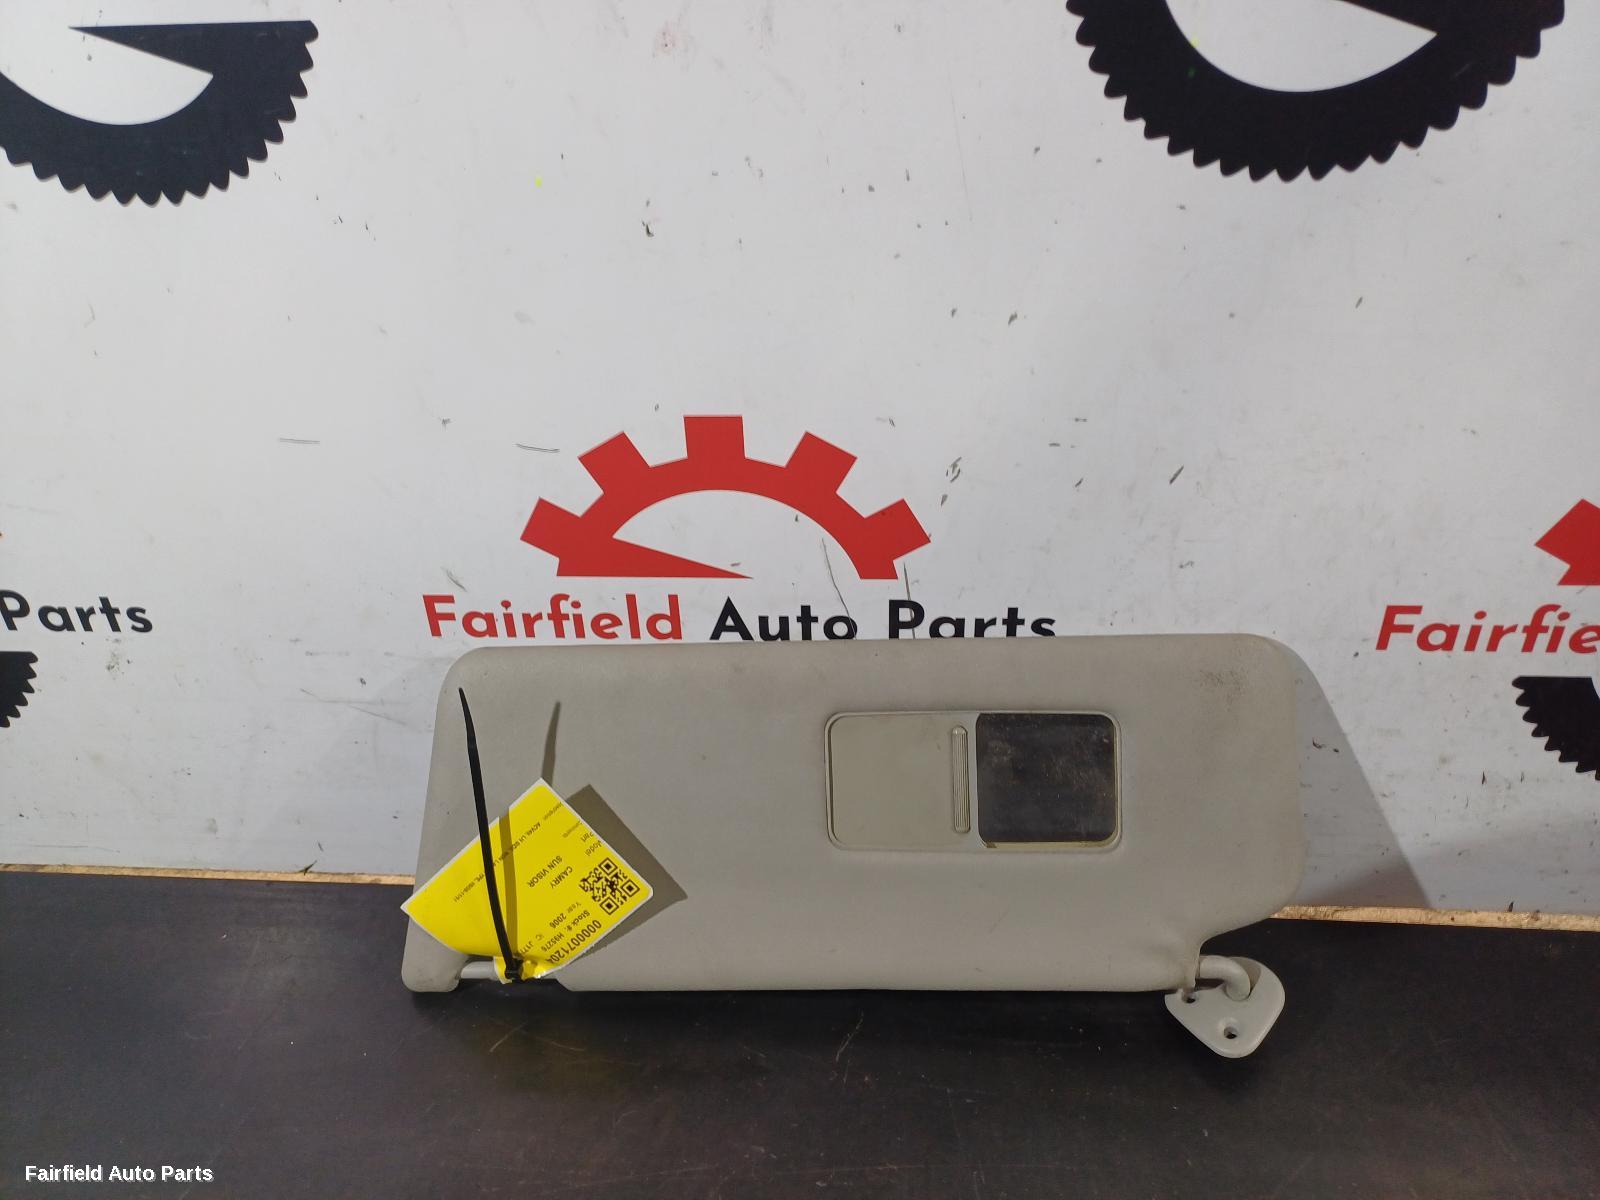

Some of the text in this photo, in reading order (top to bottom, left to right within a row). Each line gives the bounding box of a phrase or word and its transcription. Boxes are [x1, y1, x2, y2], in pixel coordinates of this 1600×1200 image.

[0, 589, 153, 633] Parts
[422, 593, 1056, 642] Fairfield Auto Parts
[547, 855, 563, 871] SUN
[527, 868, 549, 888] VISOR
[550, 865, 573, 889] CAMRY
[549, 912, 567, 929] 2006
